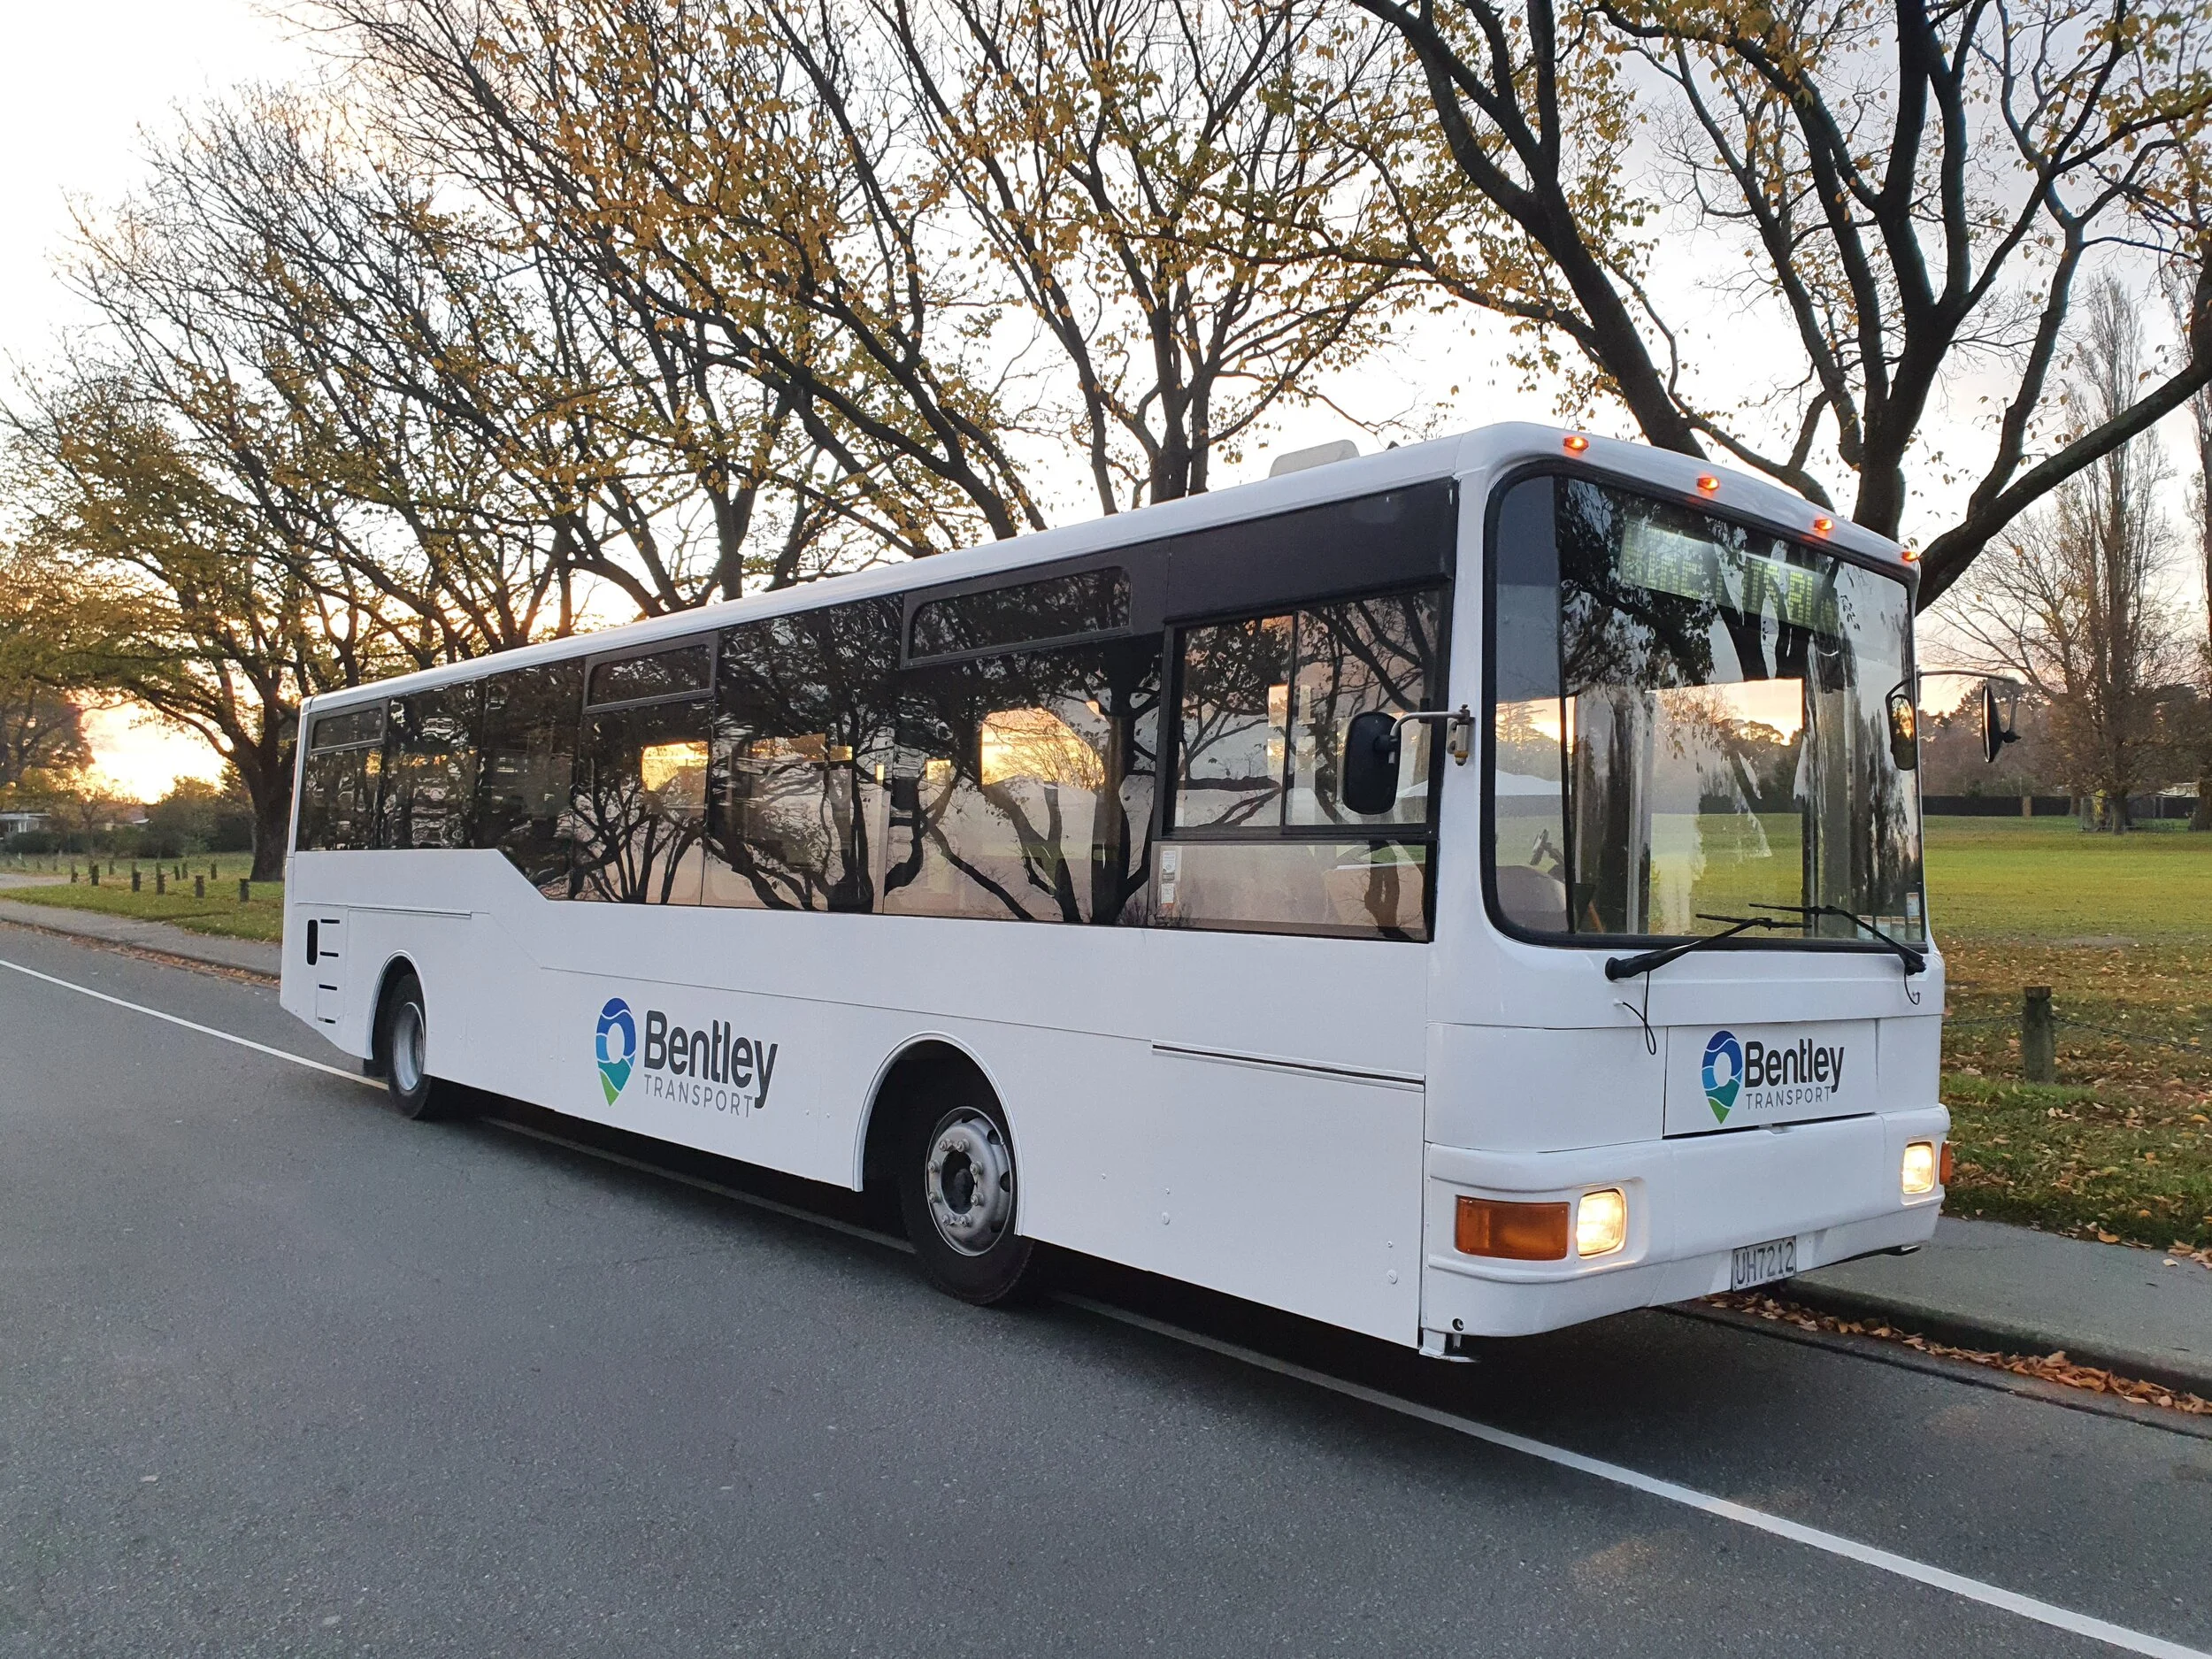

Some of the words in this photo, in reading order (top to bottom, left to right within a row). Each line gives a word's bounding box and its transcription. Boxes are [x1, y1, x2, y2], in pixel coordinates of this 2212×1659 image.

[643, 1010, 779, 1110] Bentley
[1744, 1038, 1845, 1094] Bentley
[643, 1073, 753, 1118] TRANSPORT
[1745, 1086, 1831, 1110] TRANSPORT
[1735, 1240, 1794, 1285] UH7212
